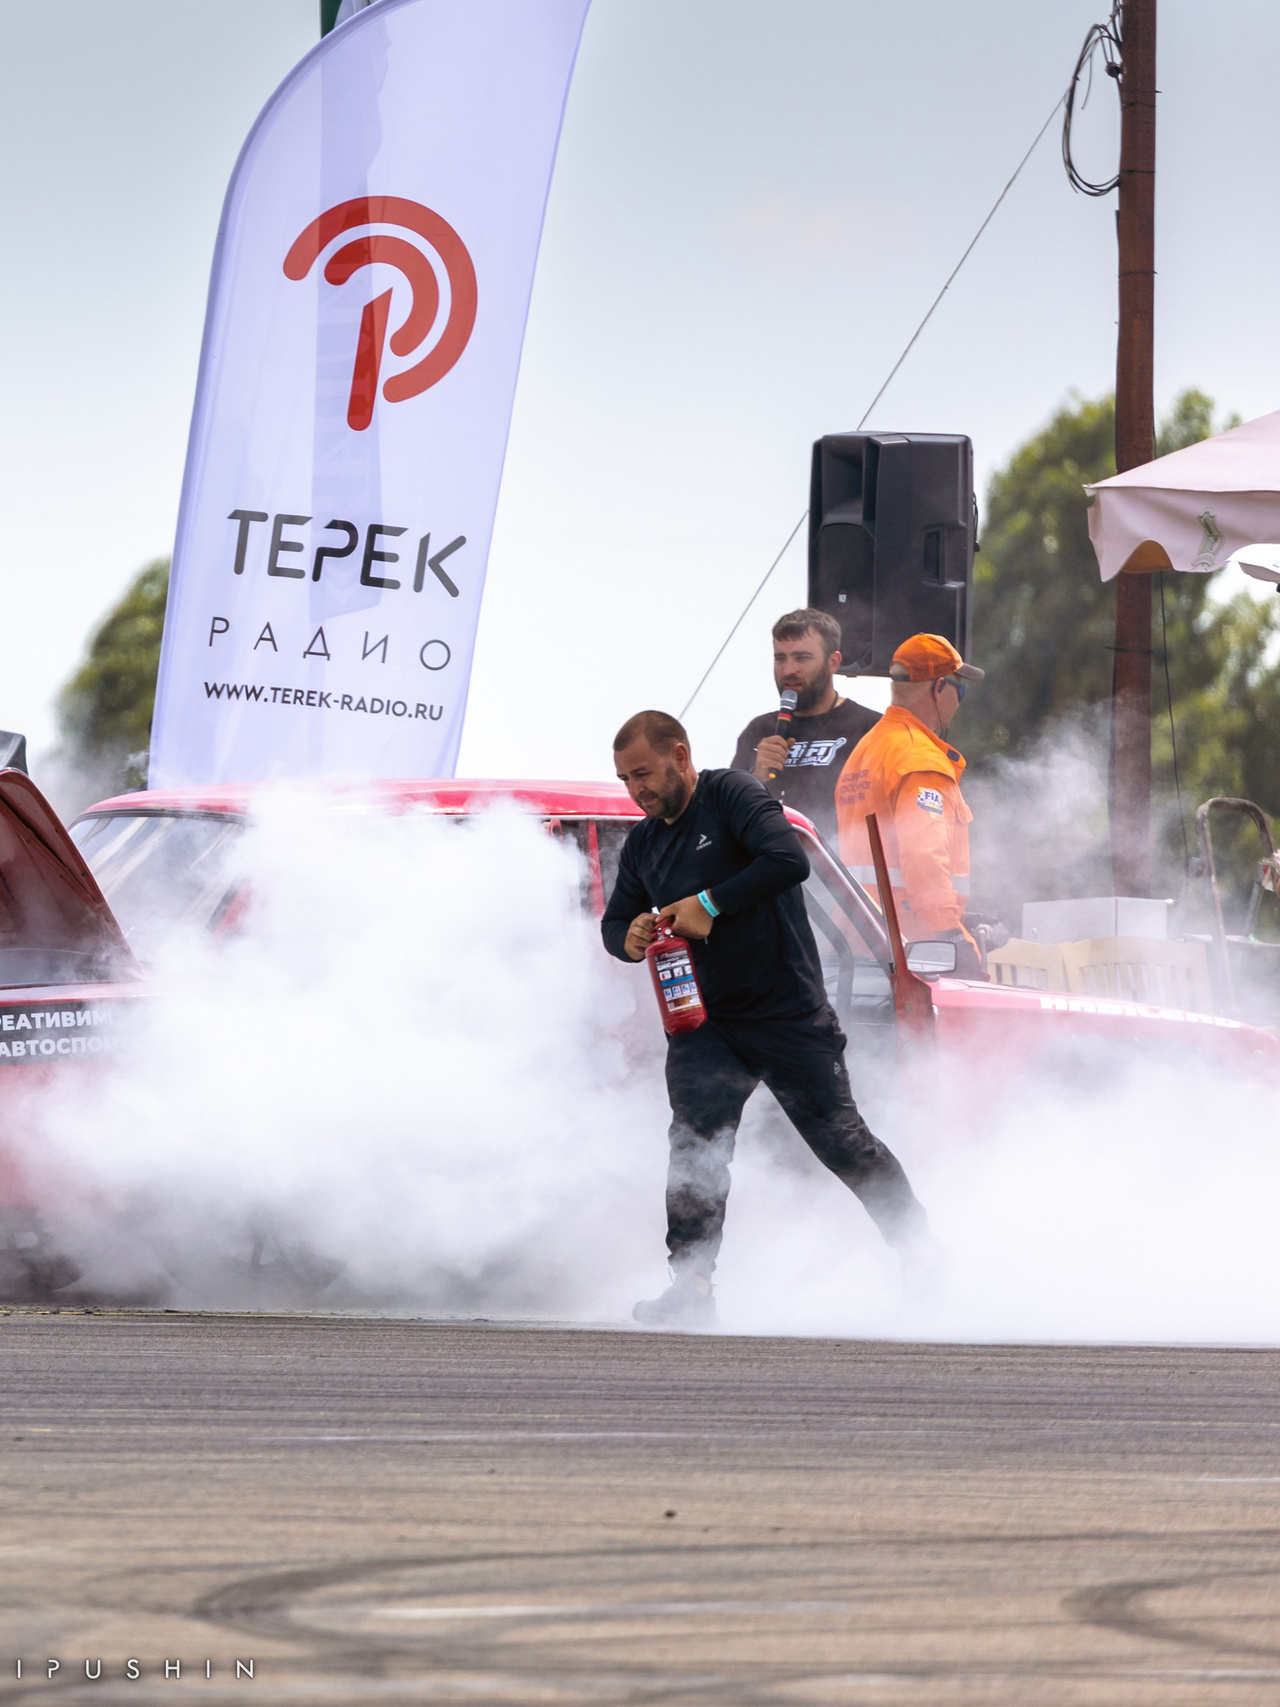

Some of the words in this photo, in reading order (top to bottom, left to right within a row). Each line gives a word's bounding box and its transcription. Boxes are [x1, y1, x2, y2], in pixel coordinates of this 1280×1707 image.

[227, 508, 467, 598] ТЕРЕК
[209, 616, 452, 671] РАДИО
[204, 681, 444, 721] WWW.TEREK-RADIO.RU
[924, 791, 940, 803] FIA
